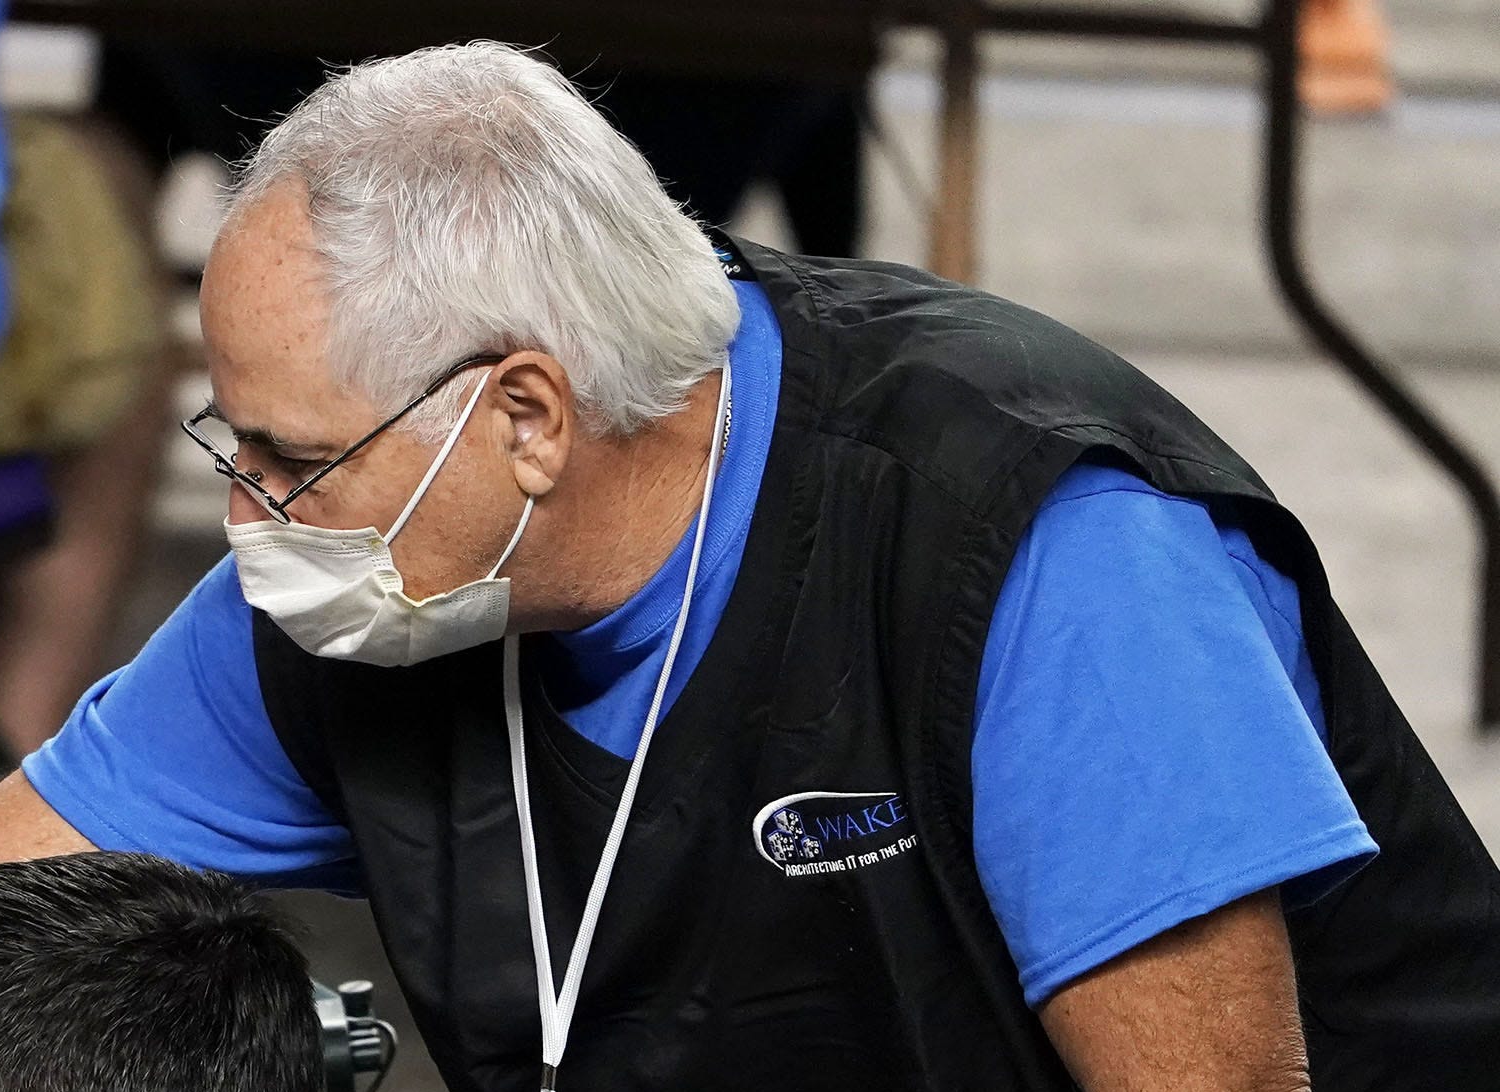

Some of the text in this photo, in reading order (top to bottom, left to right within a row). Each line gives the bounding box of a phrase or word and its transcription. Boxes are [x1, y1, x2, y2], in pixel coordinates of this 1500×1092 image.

[816, 796, 906, 841] WAKE
[846, 855, 857, 872] IT
[858, 851, 880, 866] FOR
[879, 843, 899, 860] THE
[898, 834, 917, 852] FUT
